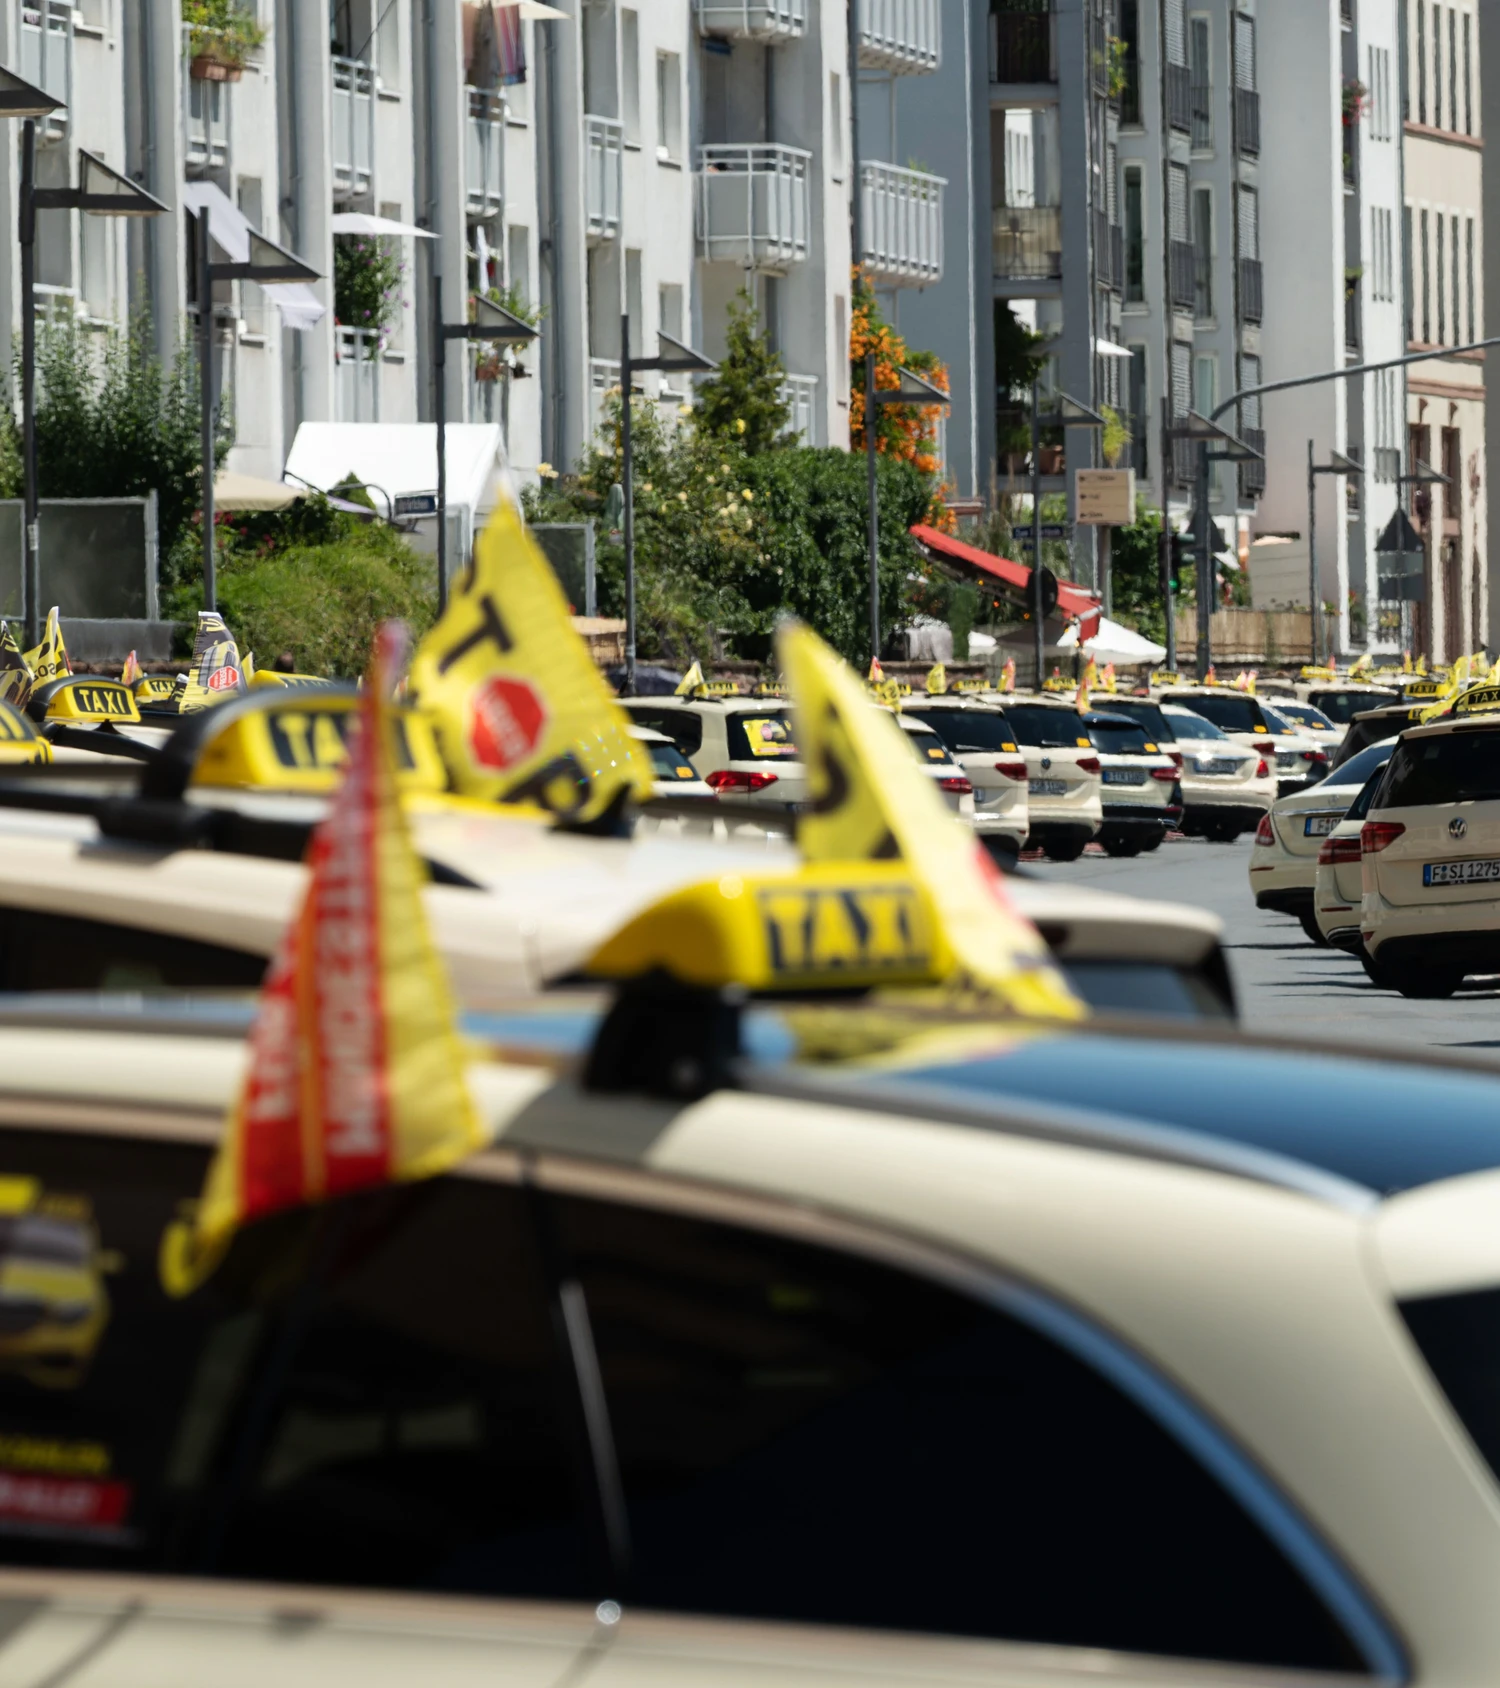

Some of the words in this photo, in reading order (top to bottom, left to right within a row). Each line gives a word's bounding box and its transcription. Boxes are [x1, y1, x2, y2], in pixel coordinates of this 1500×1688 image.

[79, 689, 128, 714] TAXI
[1467, 861, 1500, 878] 1275
[768, 888, 925, 972] TAXI
